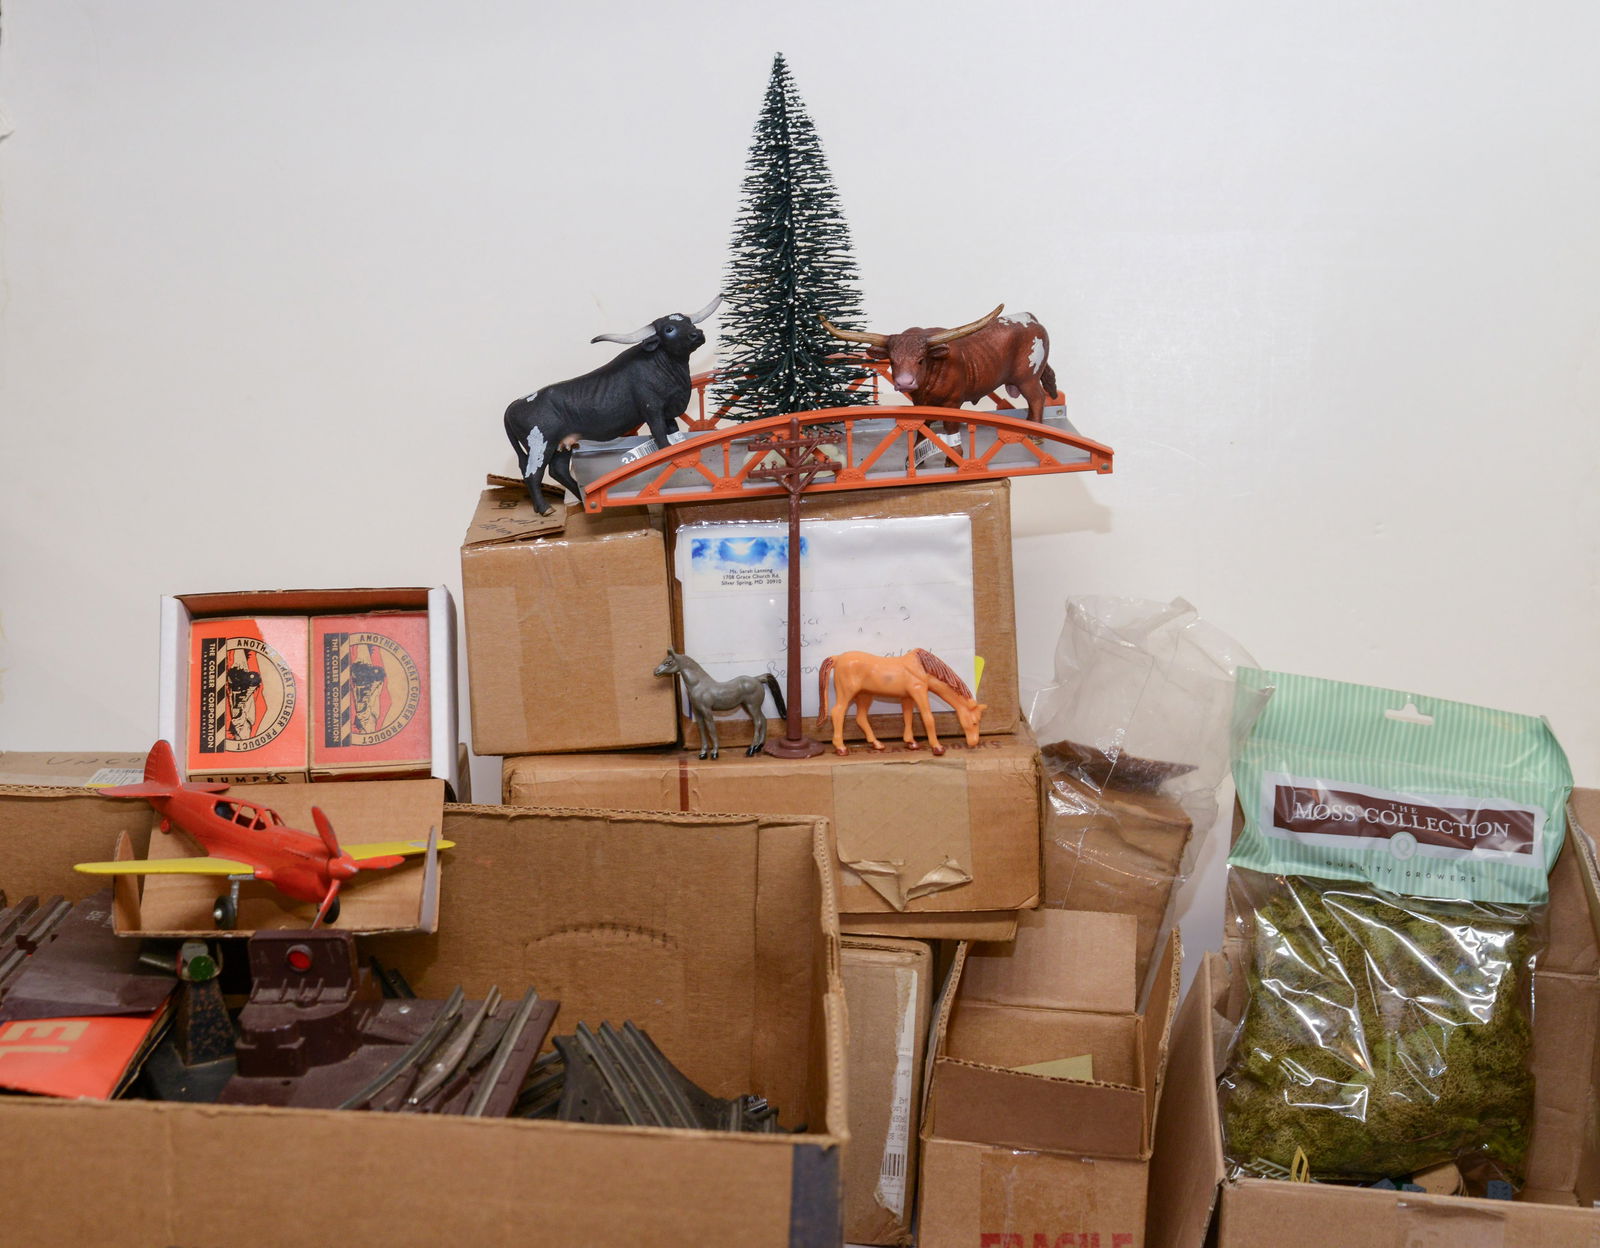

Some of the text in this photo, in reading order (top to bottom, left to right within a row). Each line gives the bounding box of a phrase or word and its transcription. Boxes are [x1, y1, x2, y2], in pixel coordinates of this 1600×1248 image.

[236, 639, 269, 655] ANOTH
[208, 660, 216, 688] COLBER
[331, 655, 339, 683] COLBER
[359, 634, 420, 745] ANOTHER GREAT COLBER PRODUCT
[207, 692, 216, 748] CORPORATION
[277, 693, 295, 731] COLBER
[332, 686, 340, 743] CORPORATION
[236, 728, 278, 751] PRODUCT
[1293, 802, 1511, 839] MOSS COLLECTION
[1388, 803, 1419, 814] THE
[1325, 859, 1477, 883] QUALITY GROWERS
